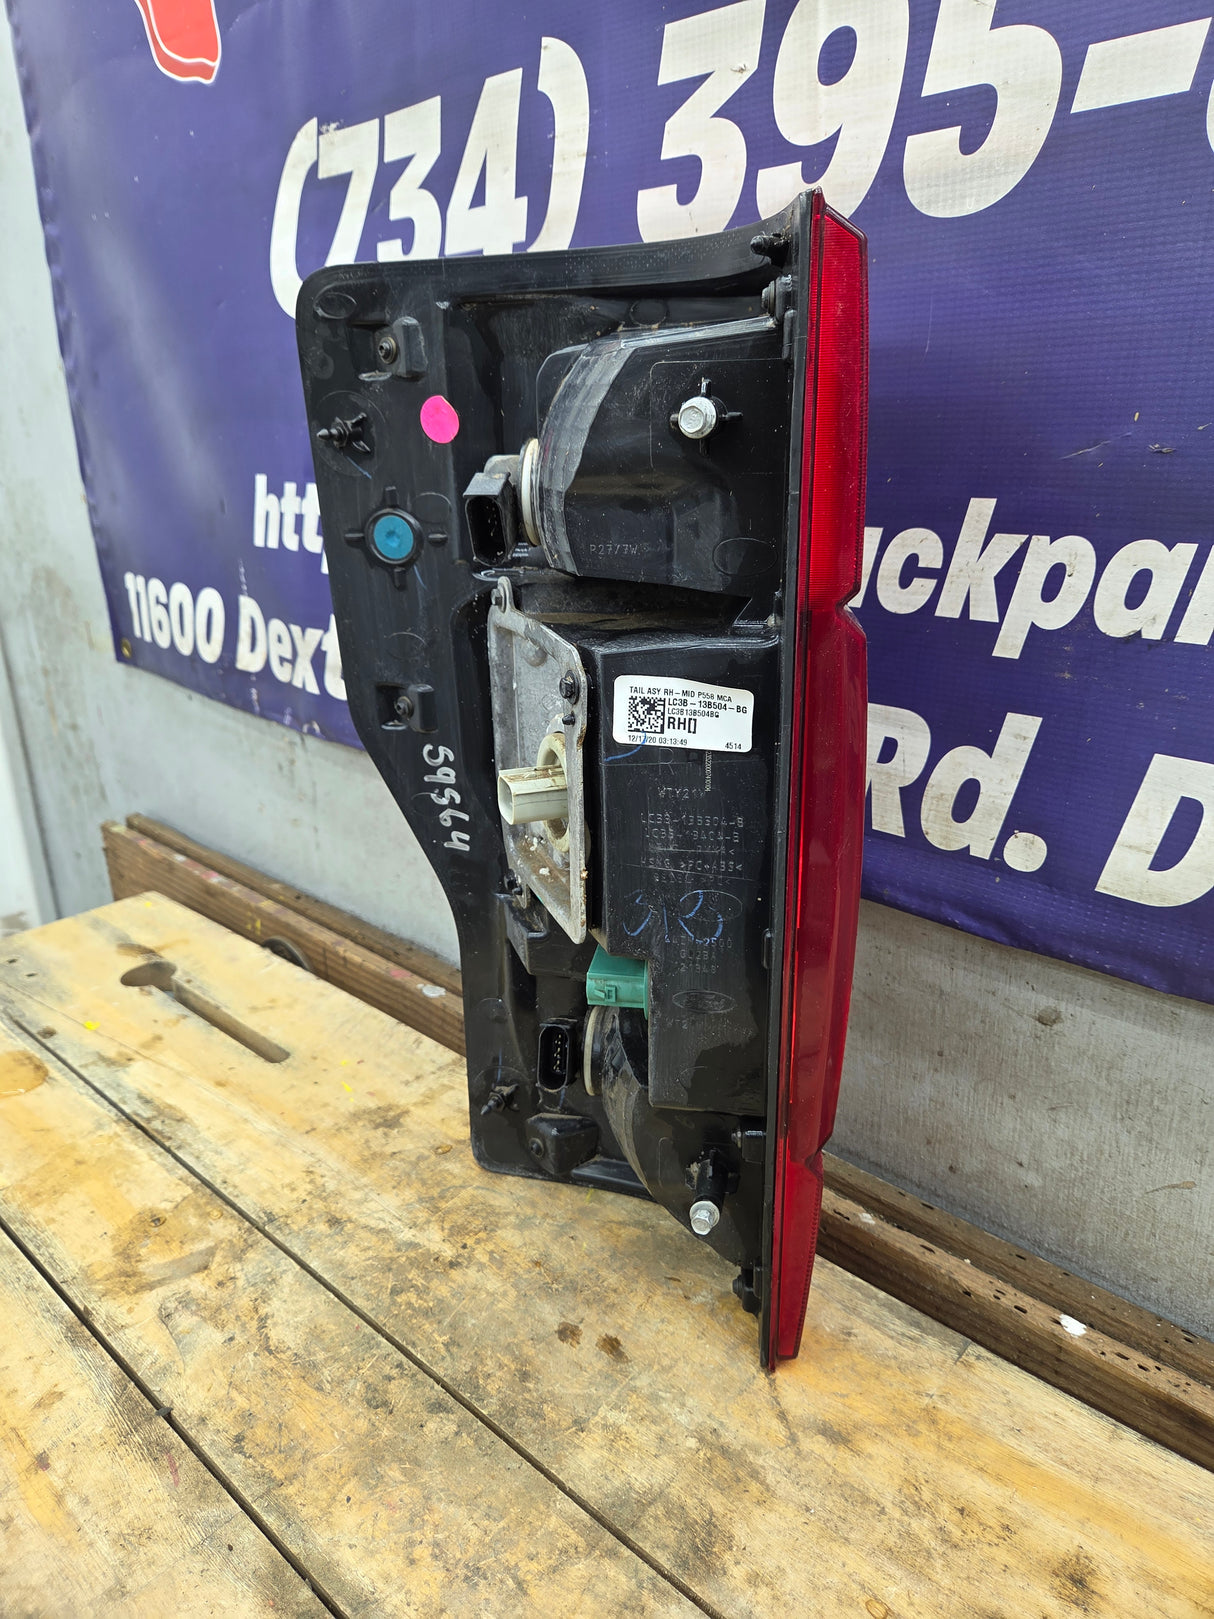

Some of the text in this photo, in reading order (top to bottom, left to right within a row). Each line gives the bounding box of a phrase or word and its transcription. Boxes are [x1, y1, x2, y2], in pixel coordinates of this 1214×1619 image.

[269, 0, 1214, 320] (734) 395-
[629, 686, 645, 695] TAIL
[647, 688, 661, 696] ASY
[698, 691, 715, 700] P558
[716, 694, 733, 703] MCA
[667, 707, 720, 719] LC3B13B504BG
[124, 571, 226, 664] 11600
[864, 702, 1047, 873] Rd.
[658, 736, 688, 746] 03:13:49
[724, 741, 742, 750] 4514
